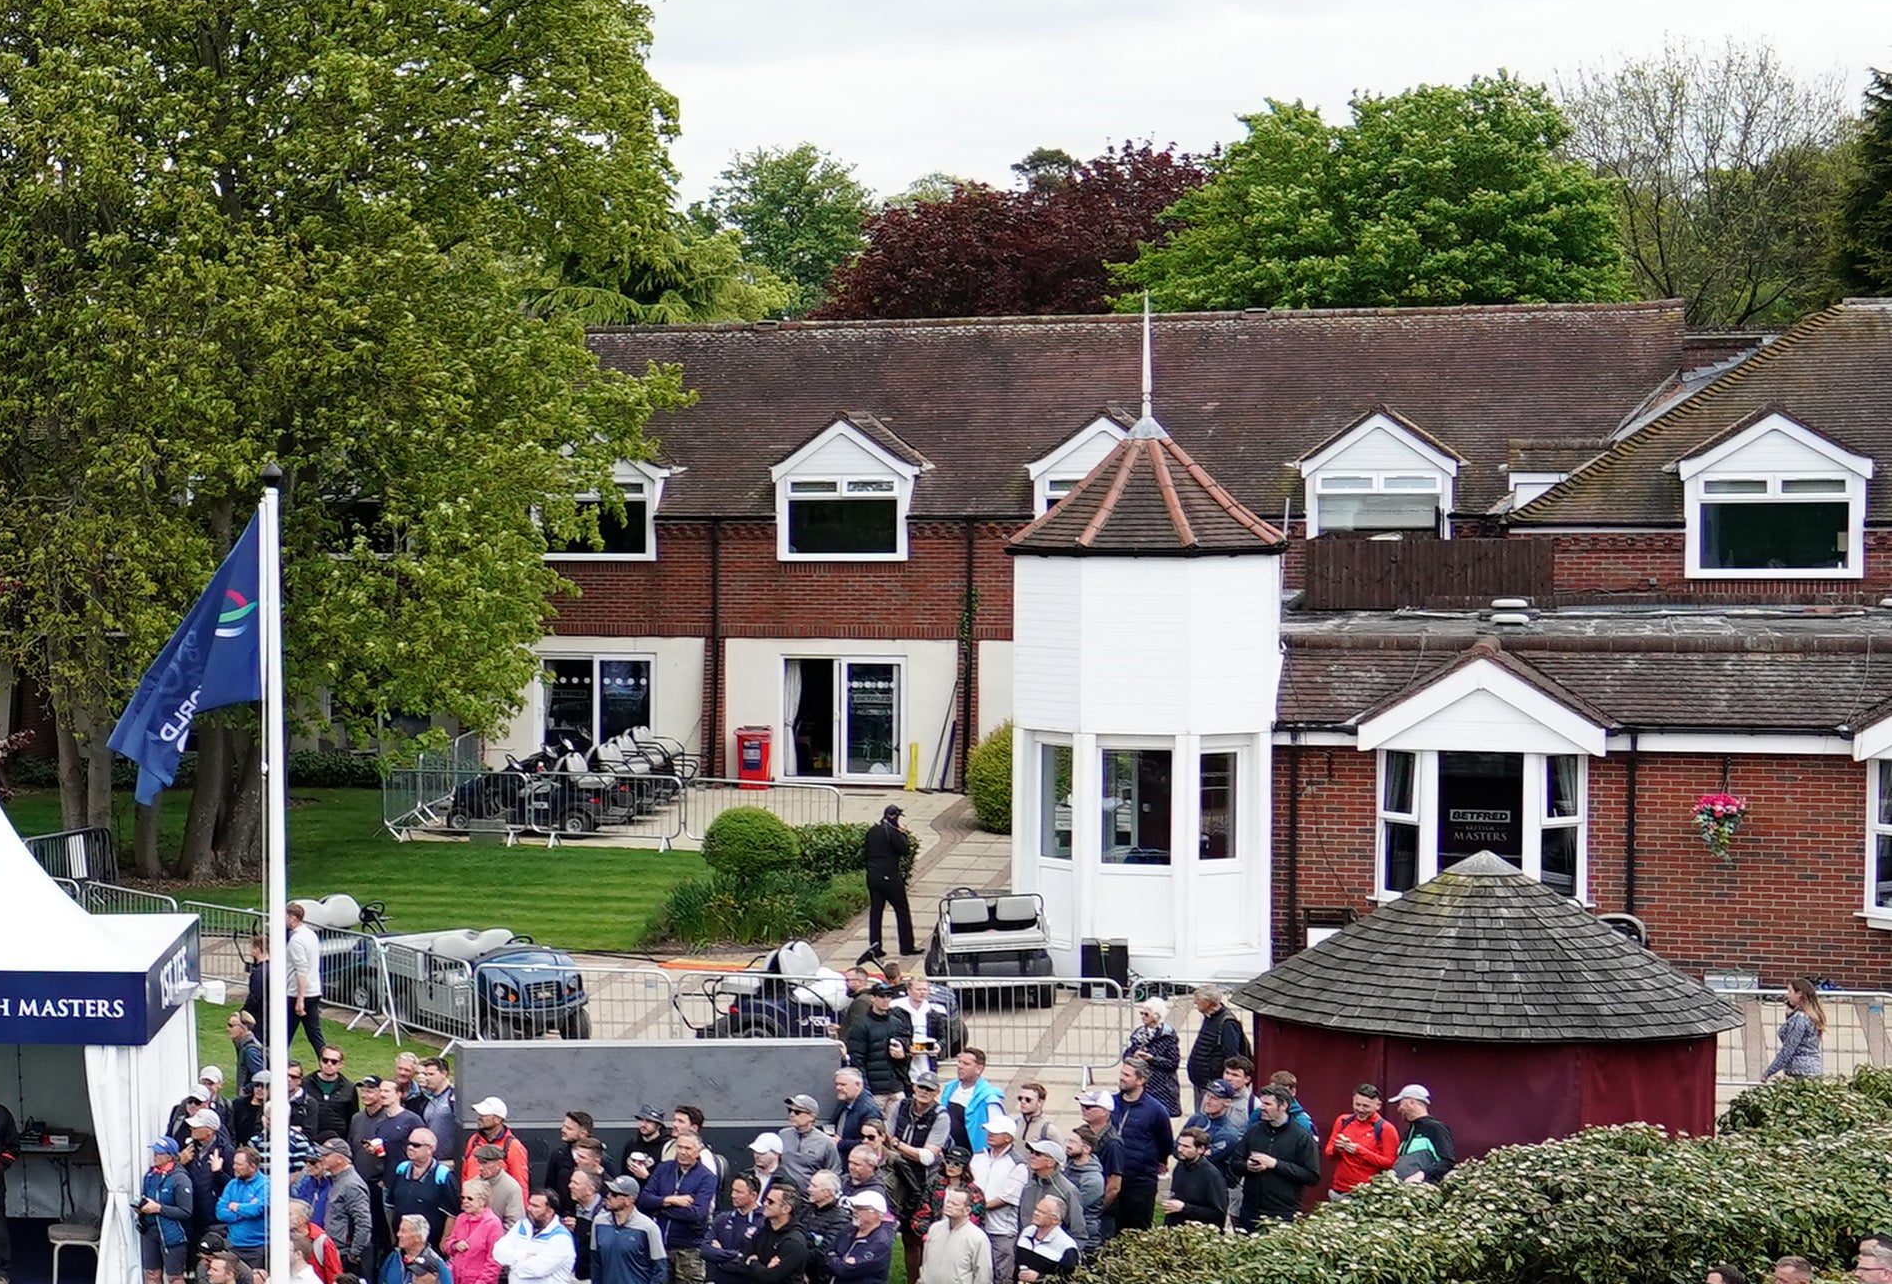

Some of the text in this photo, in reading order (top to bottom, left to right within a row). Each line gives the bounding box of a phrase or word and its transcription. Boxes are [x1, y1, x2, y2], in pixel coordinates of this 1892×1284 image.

[1452, 811, 1508, 821] BETFRED
[1454, 832, 1508, 841] MASTERS
[18, 999, 125, 1018] MASTERS
